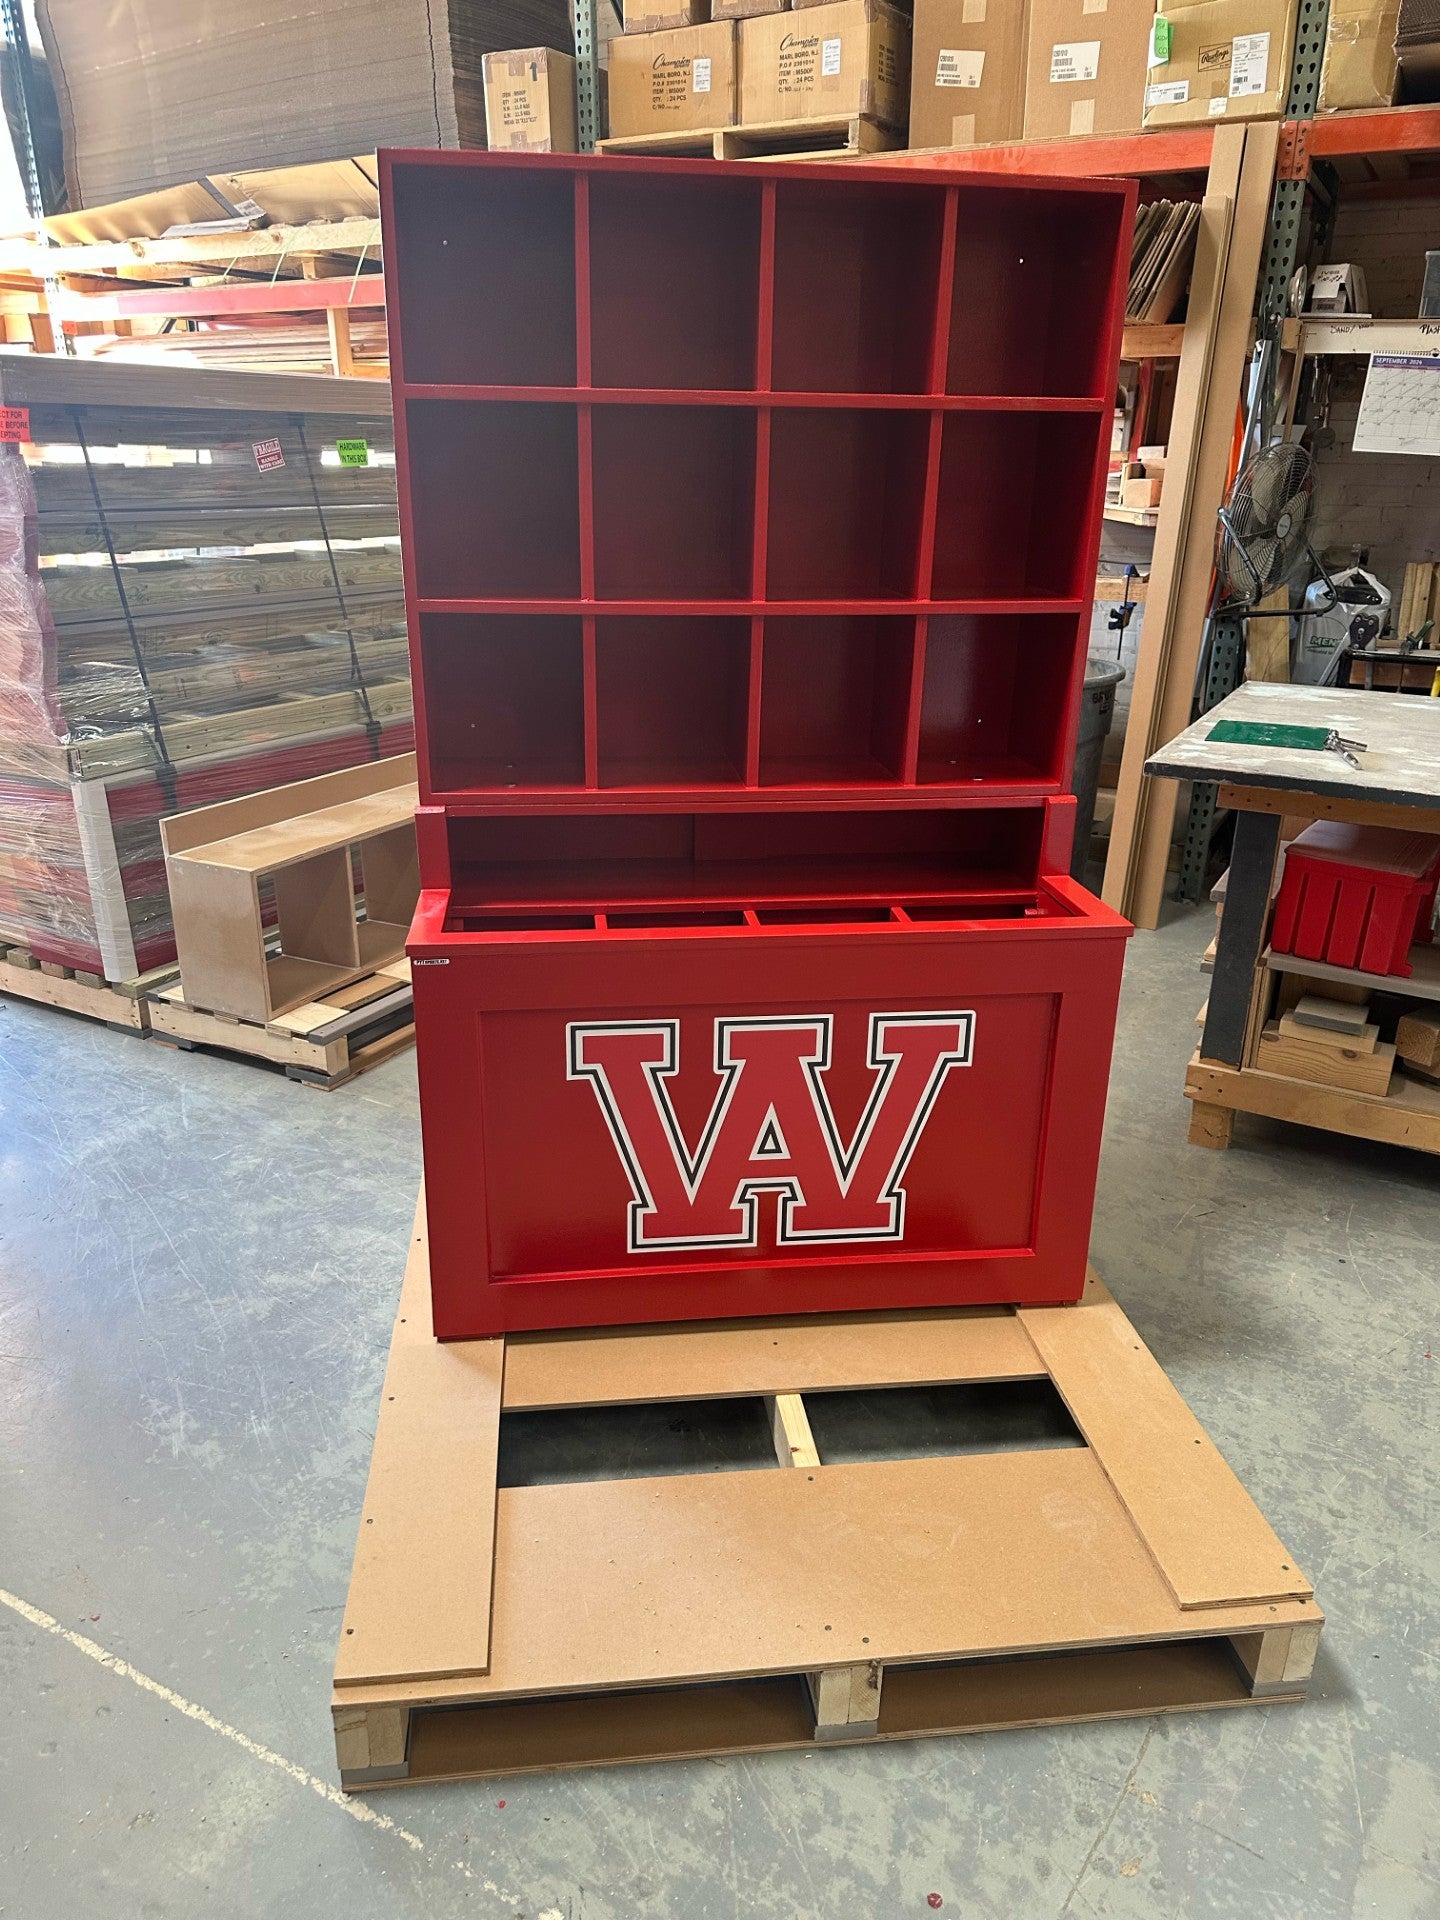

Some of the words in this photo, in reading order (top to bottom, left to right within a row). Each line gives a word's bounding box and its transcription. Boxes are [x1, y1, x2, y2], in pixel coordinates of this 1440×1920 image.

[780, 33, 819, 51] Champion
[1201, 49, 1229, 64] Rawlings
[653, 53, 690, 70] Champion
[6, 421, 28, 429] BEFORE
[0, 431, 21, 439] EPTING
[340, 442, 366, 450] HARDWARE
[347, 454, 357, 463] THIS
[357, 454, 368, 463] BOX
